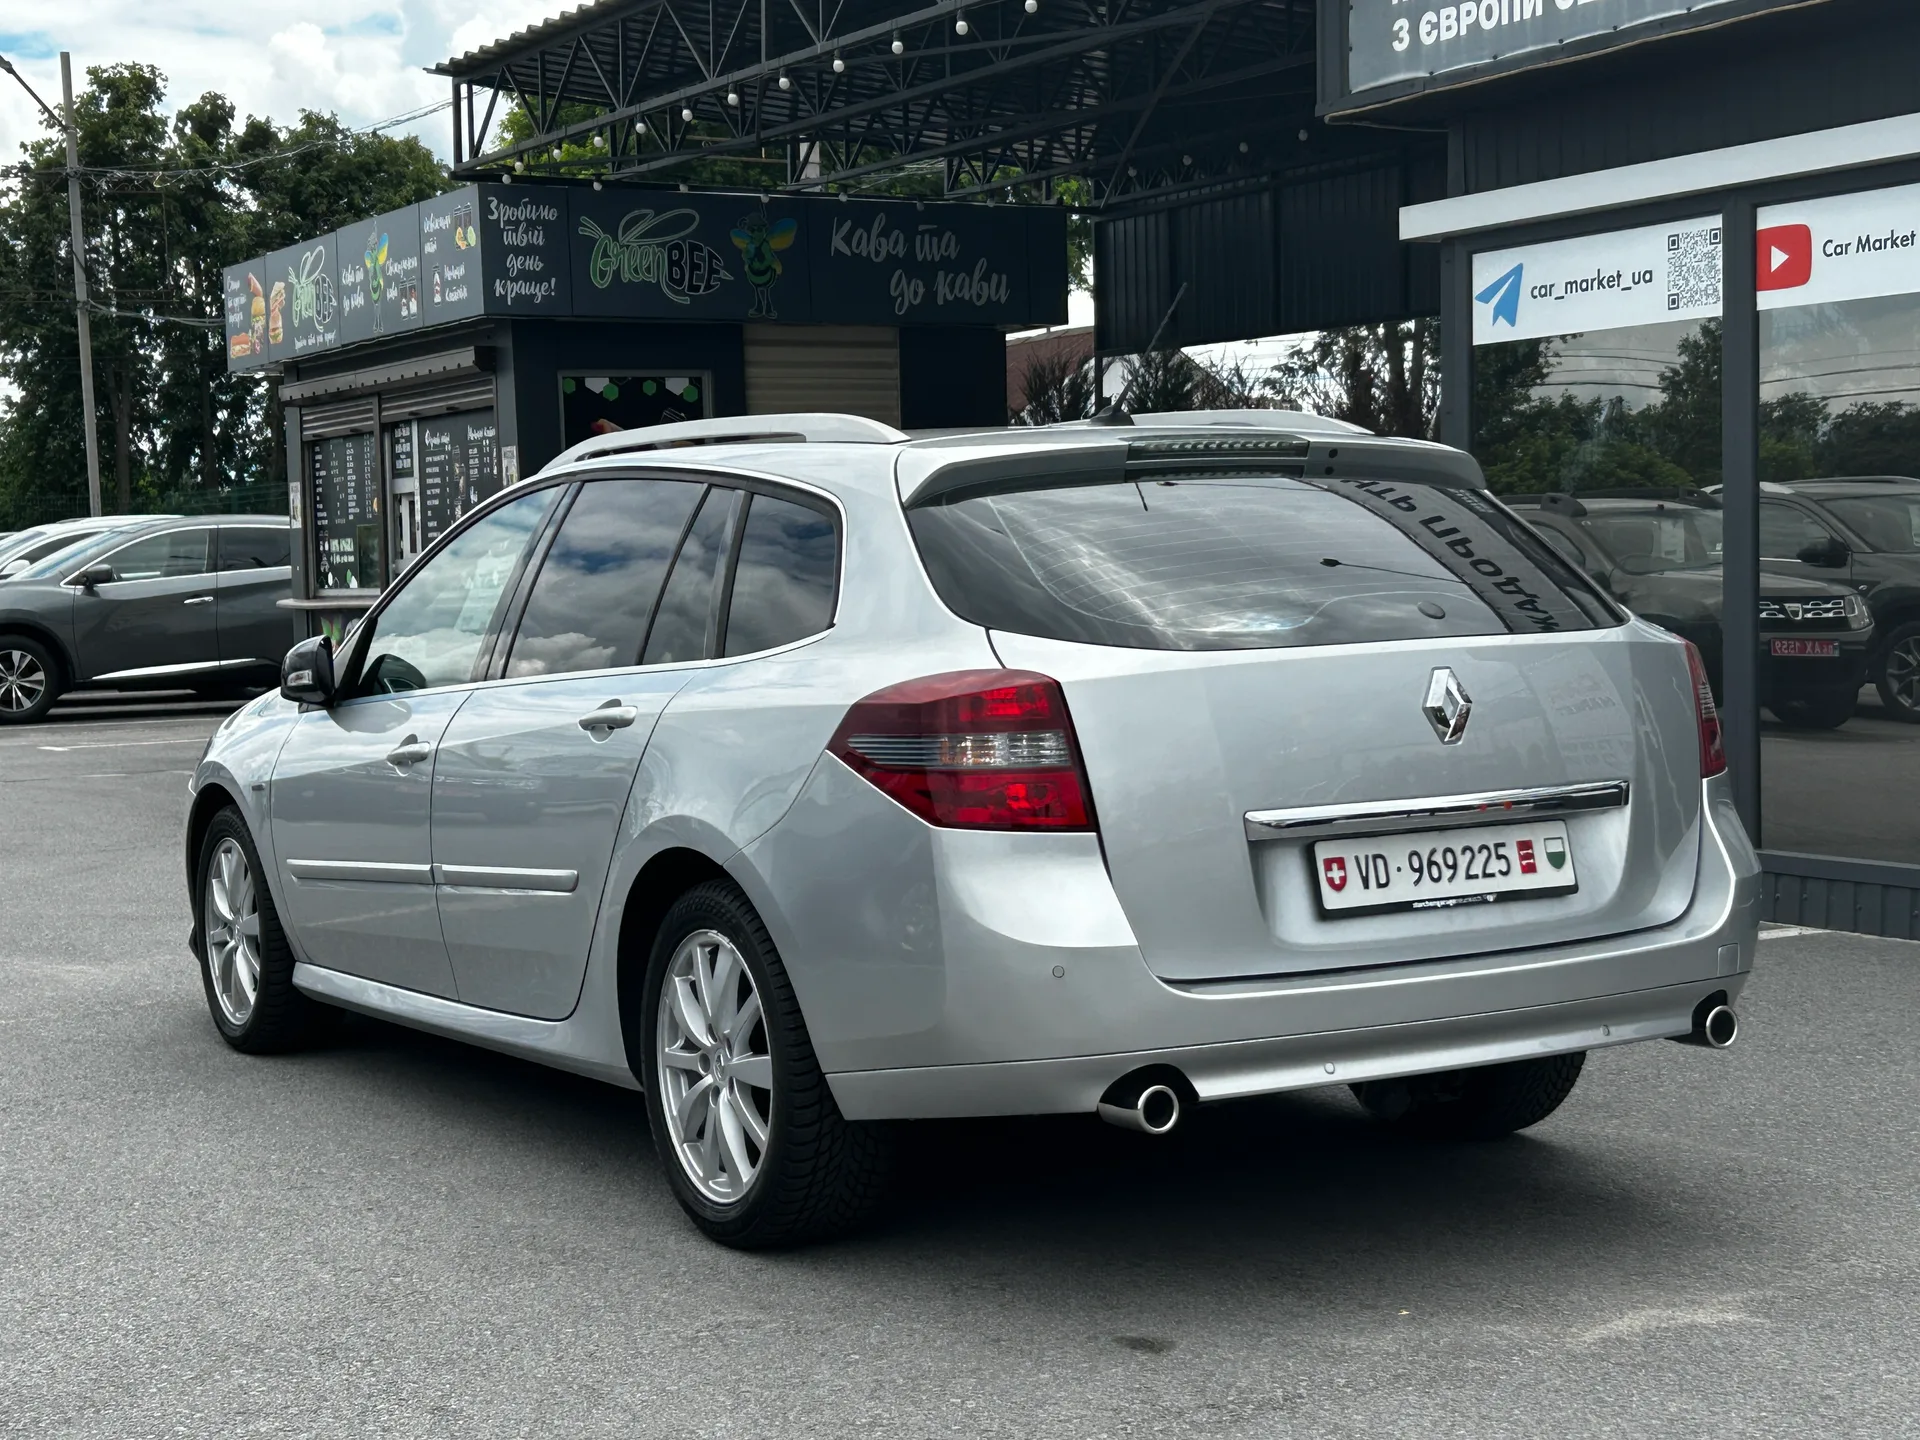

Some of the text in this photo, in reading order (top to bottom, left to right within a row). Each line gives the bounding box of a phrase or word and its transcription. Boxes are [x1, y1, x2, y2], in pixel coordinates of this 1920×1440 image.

[1392, 18, 1410, 51] З
[487, 196, 558, 228] Зробимо
[503, 222, 545, 247] твій
[830, 212, 960, 262] Кава та
[1822, 229, 1916, 257] Car Market
[506, 253, 544, 277] день
[494, 277, 556, 305] краще!
[890, 257, 1010, 315] до кави
[1530, 268, 1653, 300] car_market_ua
